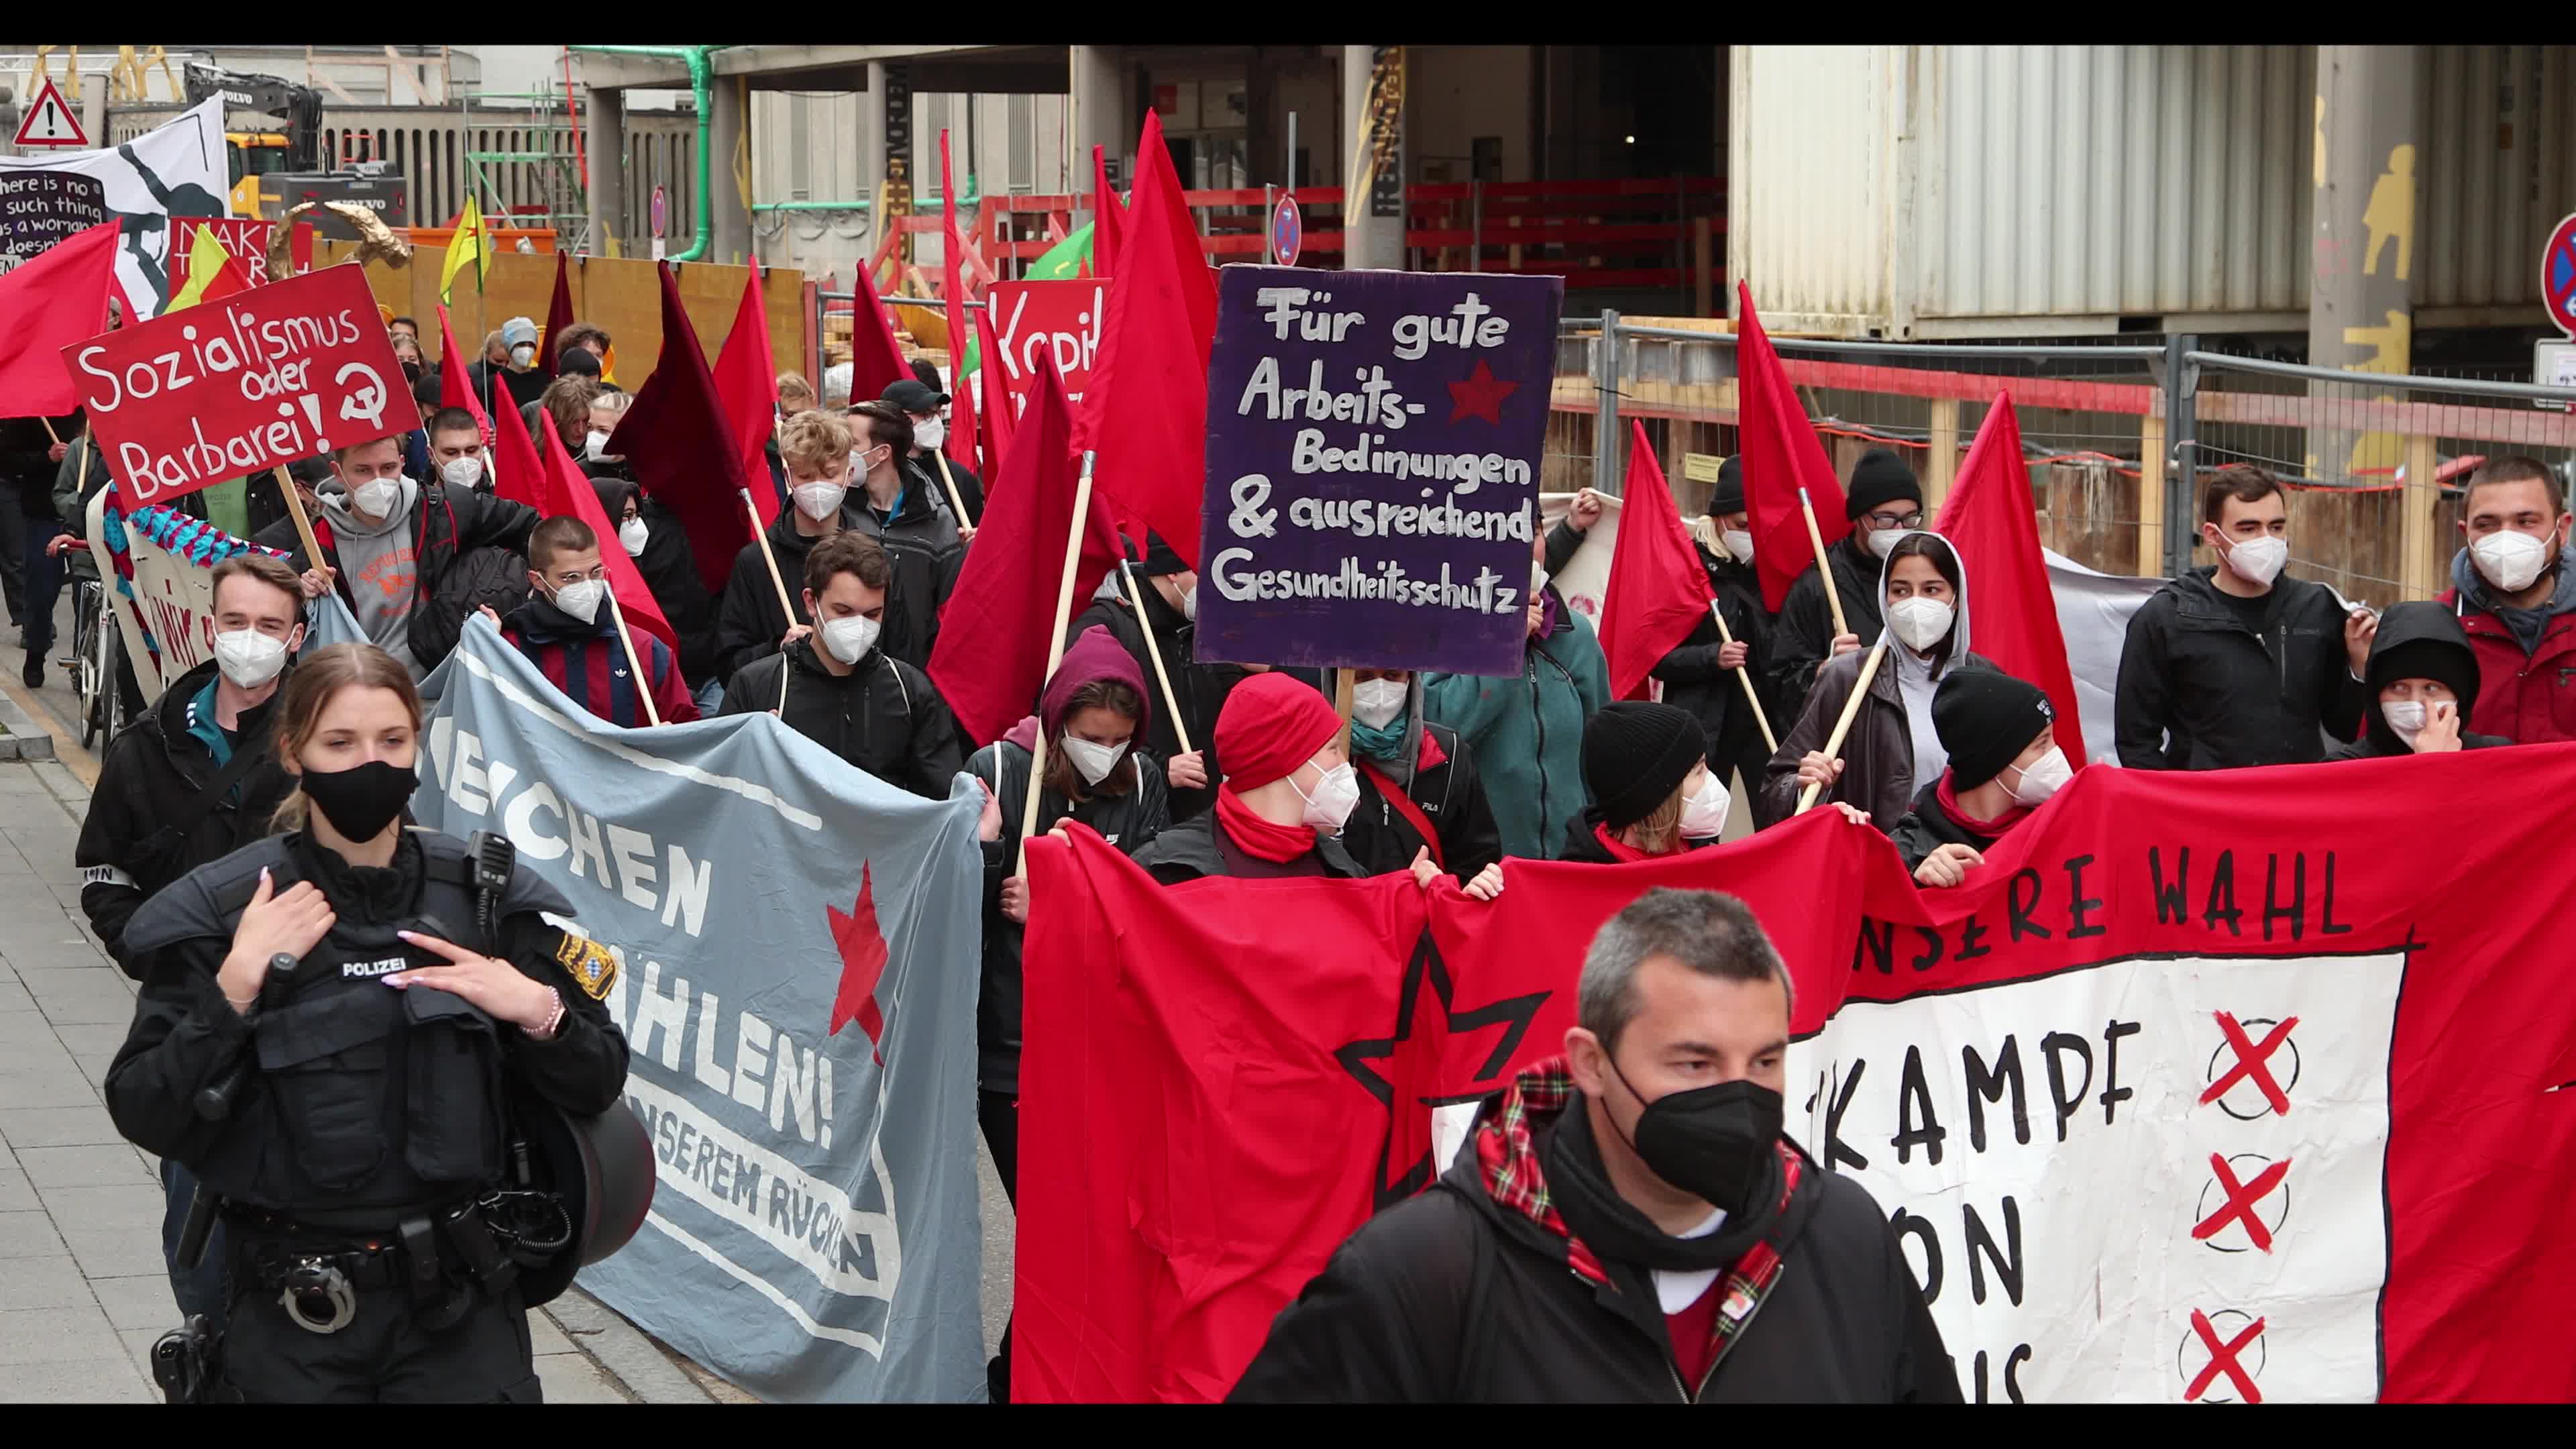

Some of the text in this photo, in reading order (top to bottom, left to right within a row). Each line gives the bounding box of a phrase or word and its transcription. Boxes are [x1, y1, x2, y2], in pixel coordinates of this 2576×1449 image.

[6, 197, 103, 225] such thing
[44, 174, 58, 191] is
[66, 180, 88, 197] no
[17, 219, 30, 234] a
[31, 218, 90, 234] woman
[179, 221, 276, 257] MAK
[1256, 287, 1509, 360] Für gute
[78, 305, 360, 413] Sozialismus
[240, 357, 311, 401] oder
[1238, 356, 1426, 429] Arbeits-
[119, 393, 331, 500] Barbarei!
[1292, 427, 1531, 495] Bedinungen
[1228, 474, 1533, 543] & ausreichend
[1211, 547, 1519, 614] Gesundheitsschutz
[1853, 845, 2353, 974] NSERE WAHL
[343, 957, 407, 977] POLIZEI
[1806, 1019, 2141, 1171] KAMPF
[621, 1095, 762, 1216] NSEREM
[1889, 1195, 2025, 1307] ON
